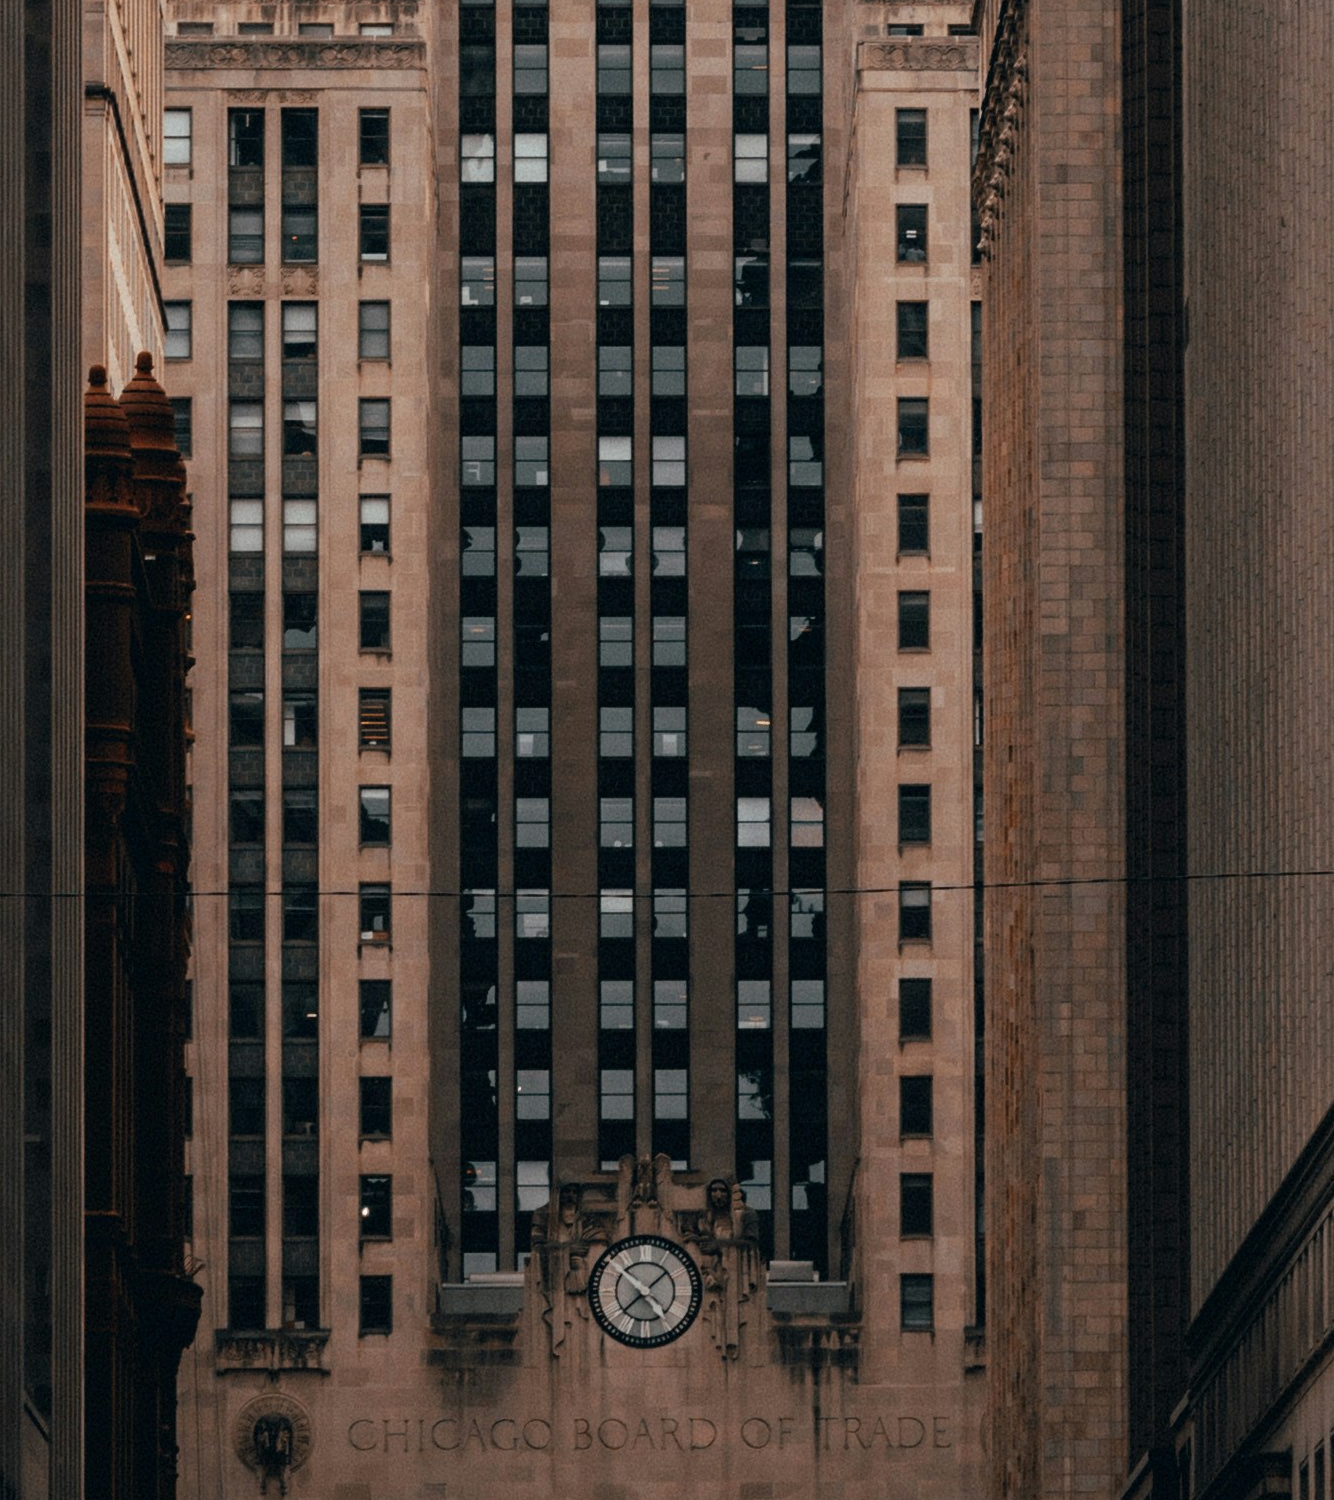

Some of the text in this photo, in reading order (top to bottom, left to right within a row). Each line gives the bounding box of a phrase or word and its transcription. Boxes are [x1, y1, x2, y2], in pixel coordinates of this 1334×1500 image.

[347, 1415, 953, 1453] CHICAGO BOARD OF TRADE
